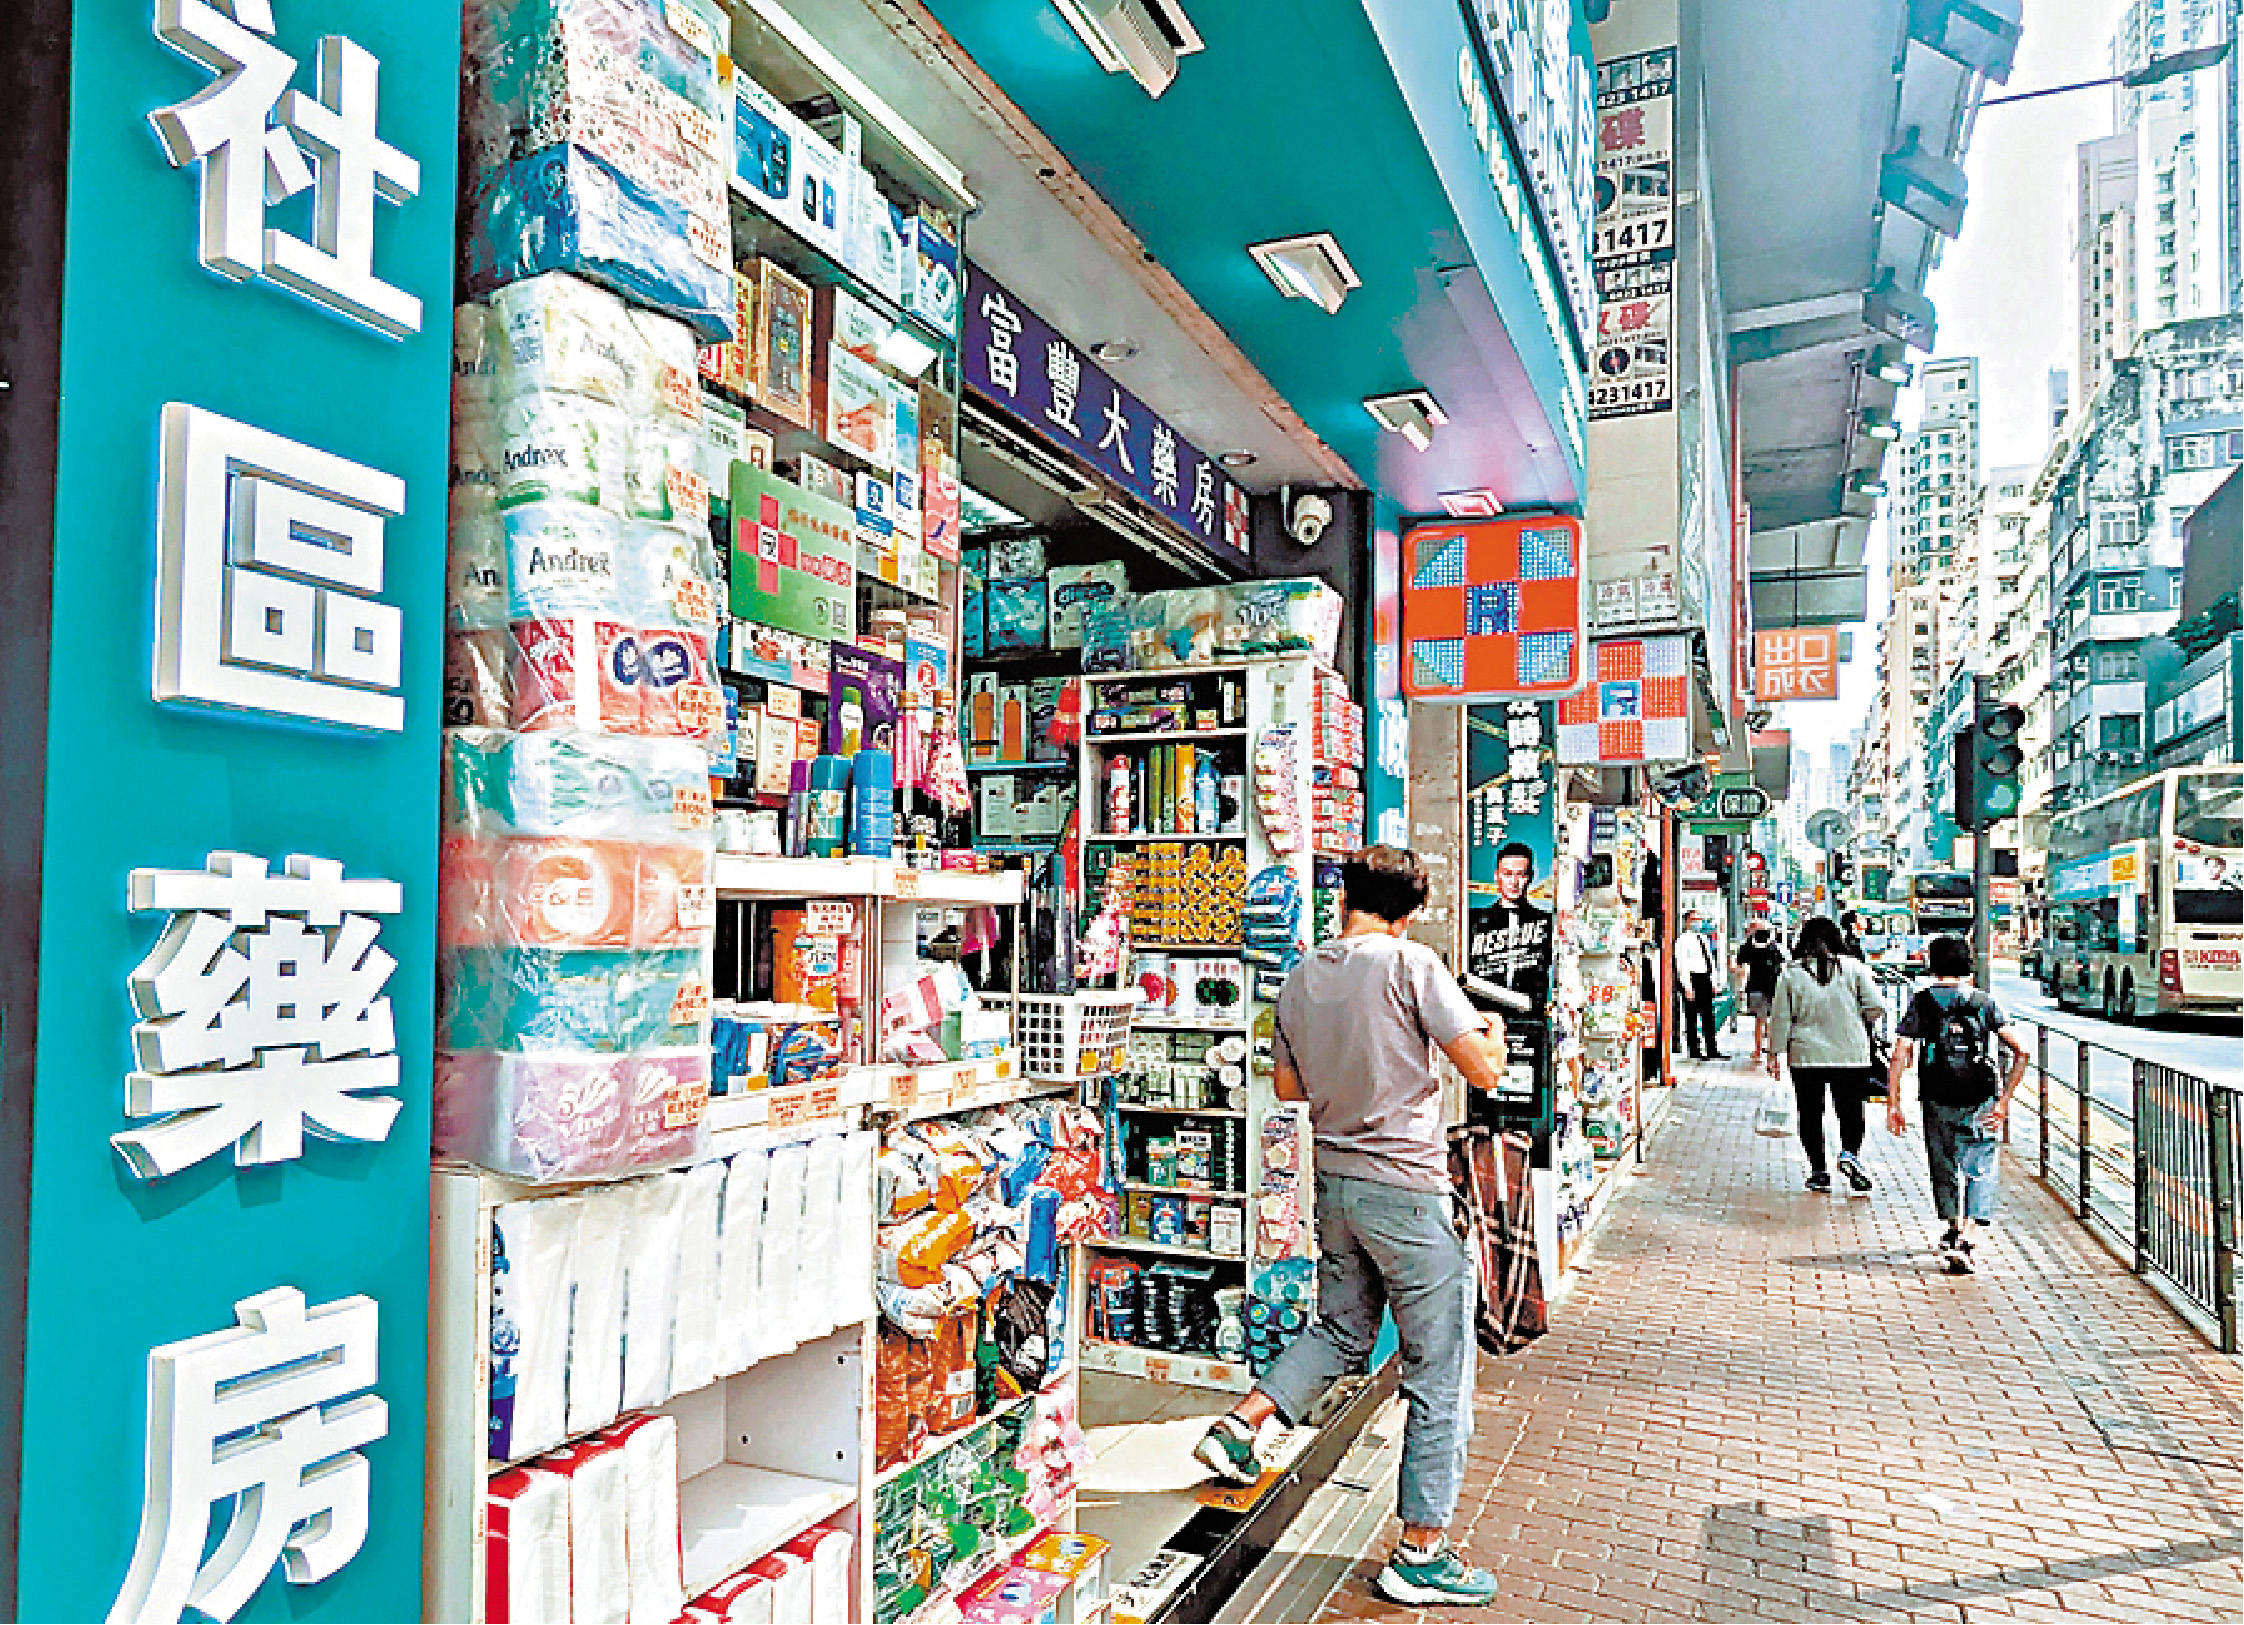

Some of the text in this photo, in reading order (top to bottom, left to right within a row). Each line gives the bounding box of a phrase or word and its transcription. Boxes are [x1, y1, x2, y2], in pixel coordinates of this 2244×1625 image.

[979, 293, 1216, 537] 富豐大藥房
[1762, 633, 1830, 664] 出口
[1762, 667, 1830, 697] 成衣
[105, 0, 423, 1624] 社區藥房
